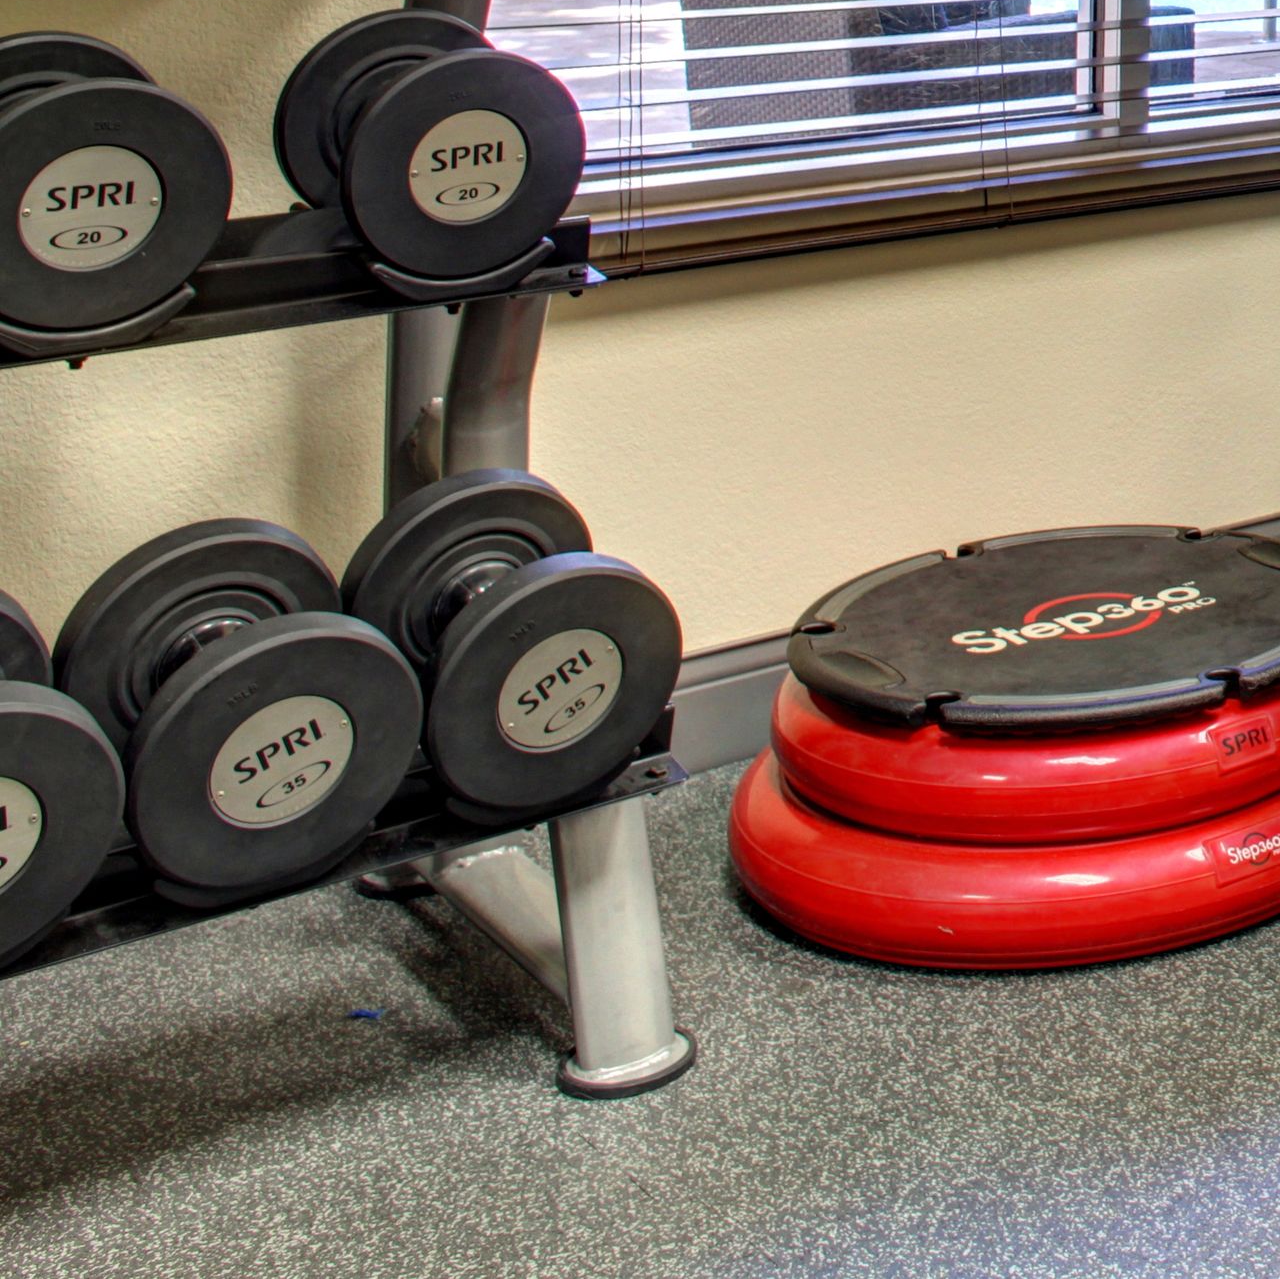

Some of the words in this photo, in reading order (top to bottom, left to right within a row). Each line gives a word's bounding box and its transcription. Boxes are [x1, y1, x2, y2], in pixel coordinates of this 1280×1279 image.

[431, 141, 503, 172] SPRI
[46, 181, 135, 212] SPRI
[458, 187, 478, 201] 20
[77, 231, 101, 245] 20
[951, 585, 1201, 654] Step360
[1168, 597, 1217, 614] PRO
[517, 648, 593, 716] SPRI
[564, 698, 586, 718] 35
[233, 718, 323, 785] SPRI
[1221, 726, 1269, 756] SPRI
[282, 774, 307, 794] 35
